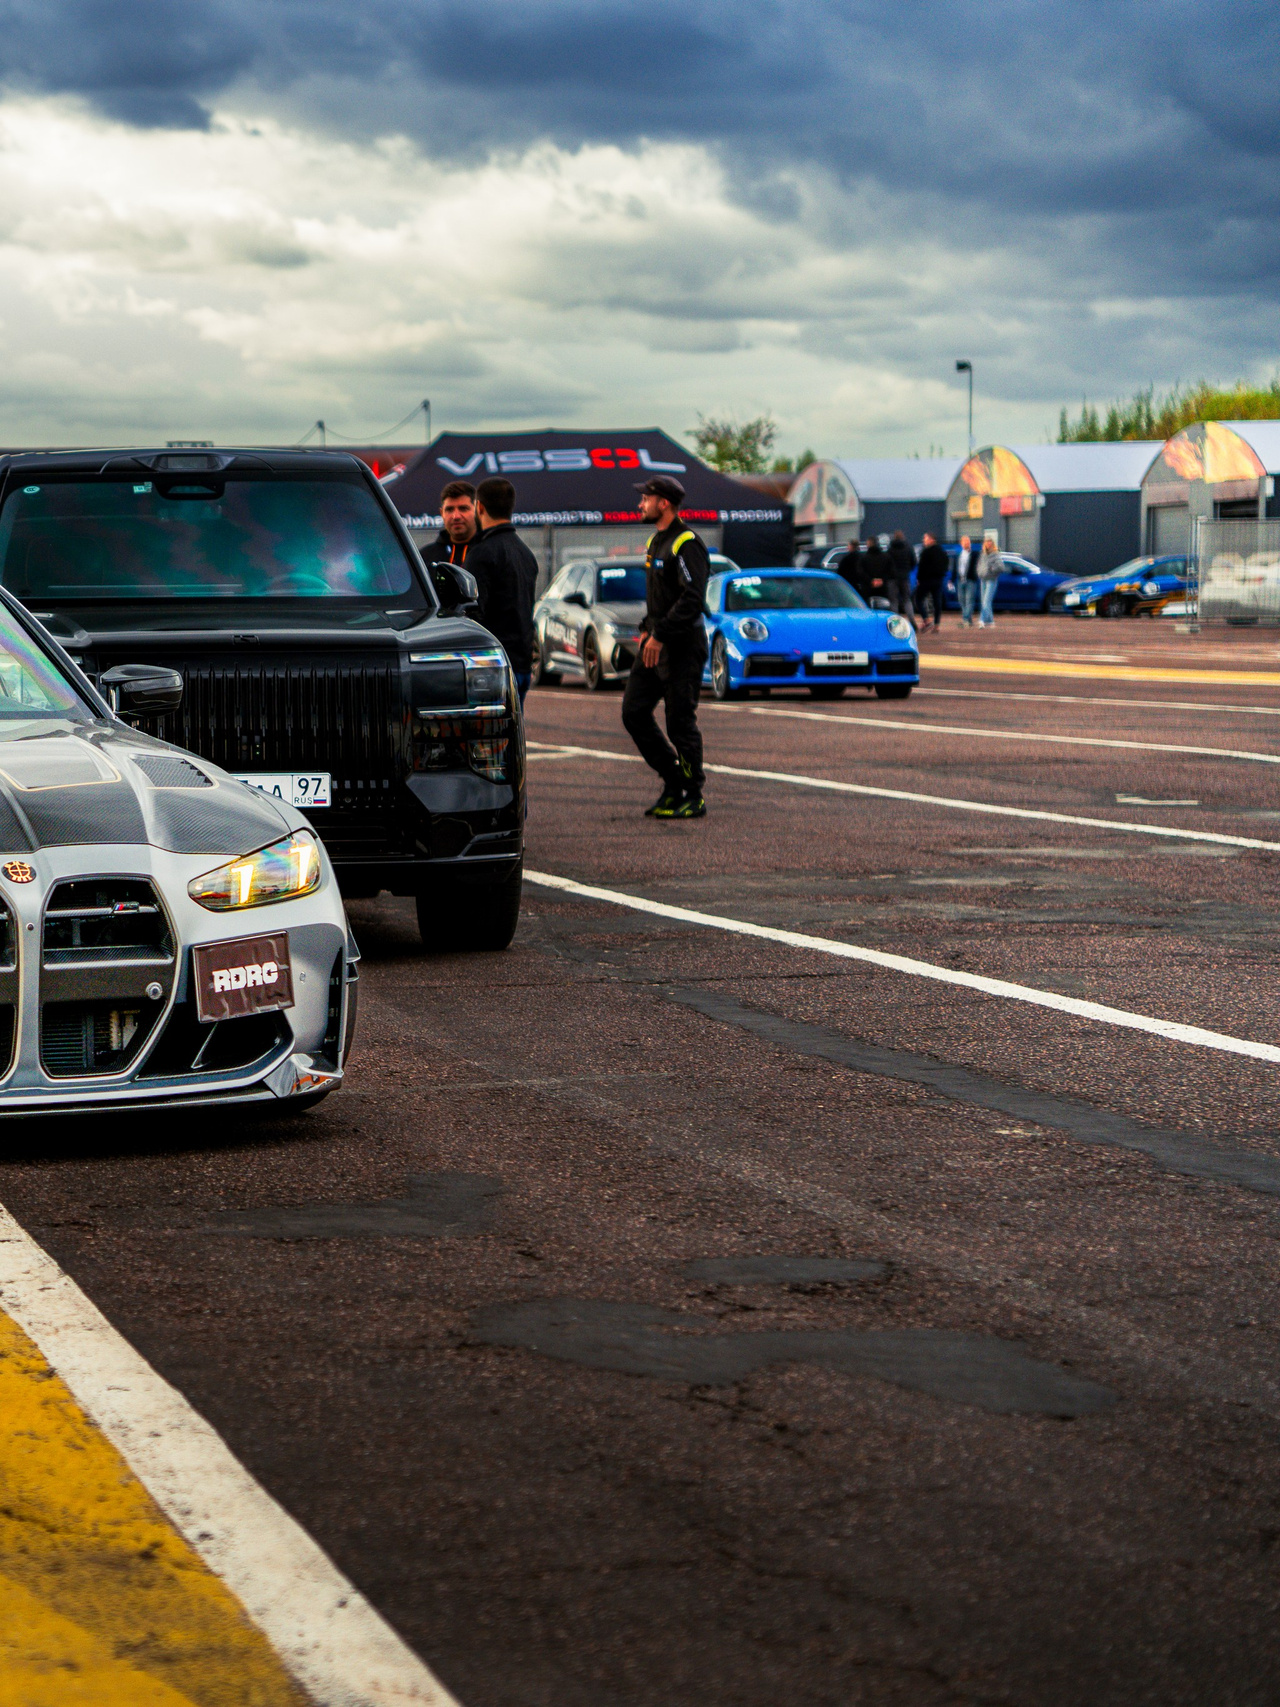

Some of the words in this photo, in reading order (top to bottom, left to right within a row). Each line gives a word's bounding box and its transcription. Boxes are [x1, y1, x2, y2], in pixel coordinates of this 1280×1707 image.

[436, 447, 687, 476] VISSOL
[298, 777, 322, 796] 97
[294, 796, 313, 804] RUS
[212, 961, 279, 993] RDRC
